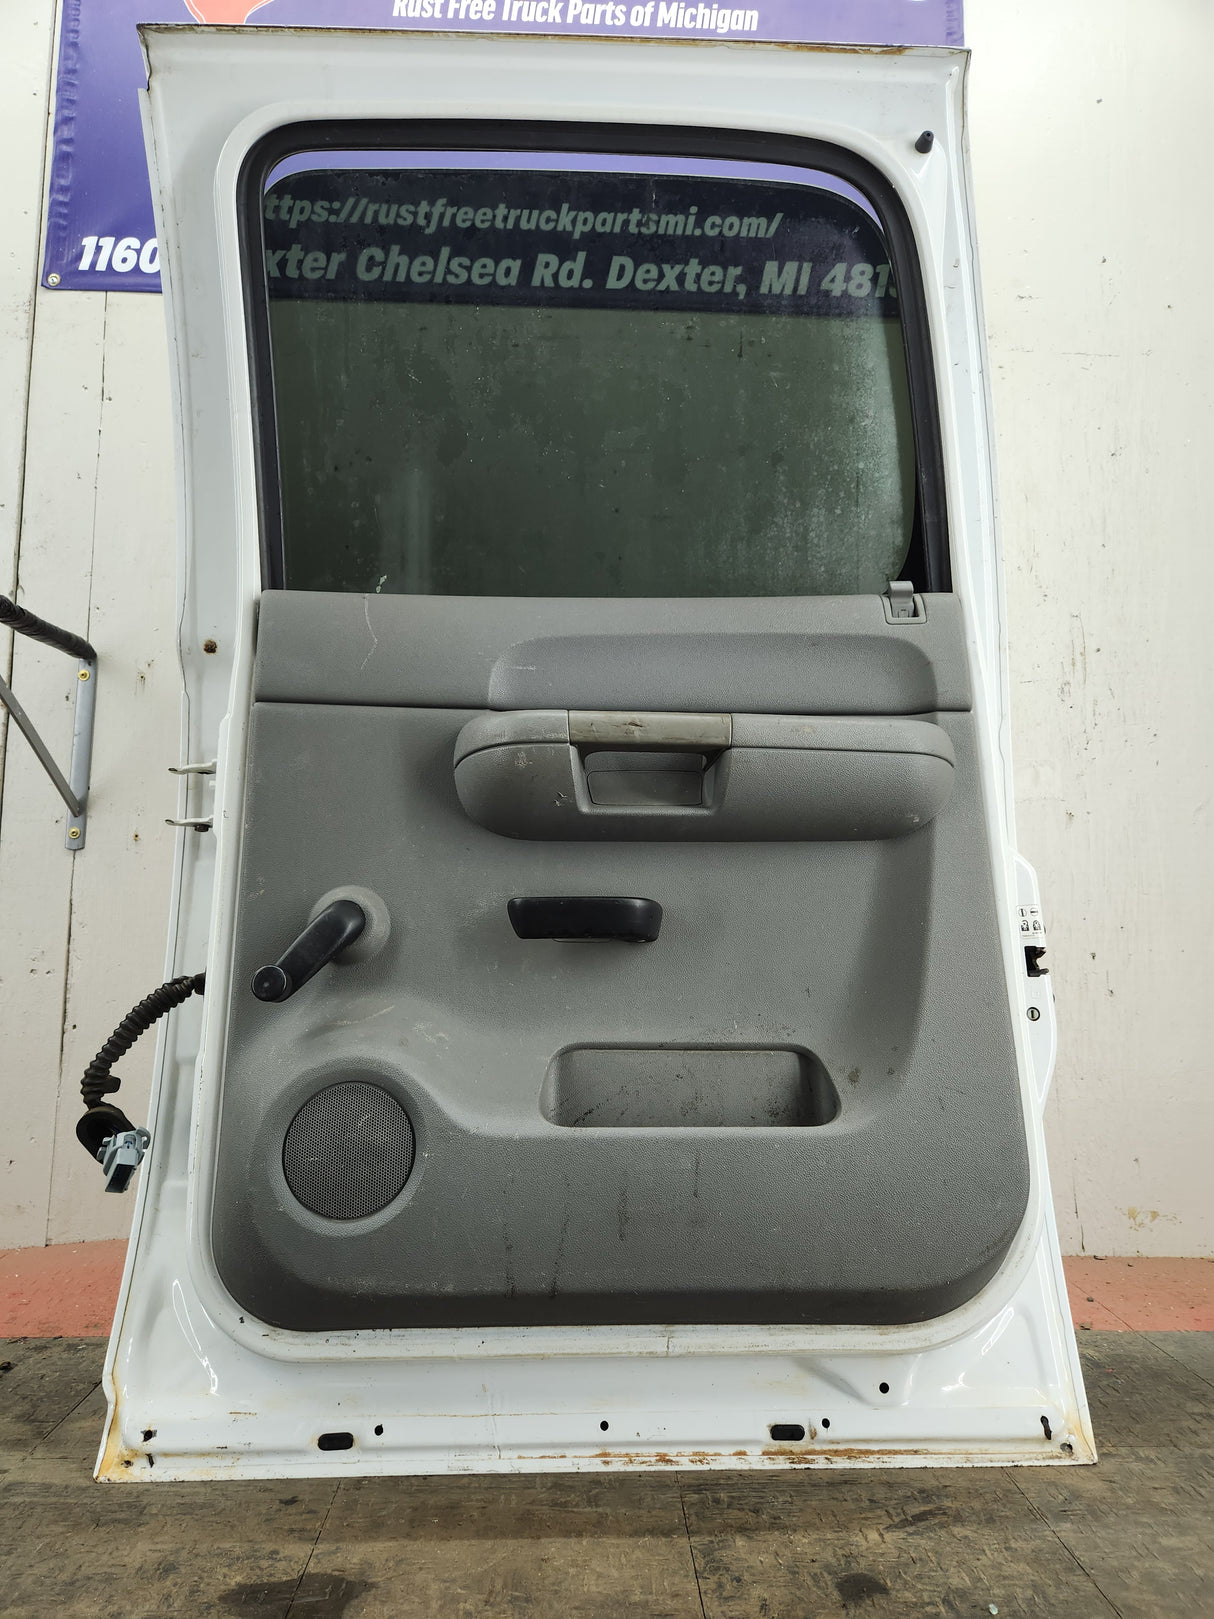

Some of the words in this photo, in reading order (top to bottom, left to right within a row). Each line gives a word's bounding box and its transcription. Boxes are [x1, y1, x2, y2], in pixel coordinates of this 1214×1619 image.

[392, 0, 443, 18] Rust
[447, 0, 497, 21] Free
[502, 0, 563, 24] Truck
[566, 0, 626, 27] Parts
[630, 2, 656, 27] of
[657, 2, 759, 33] Michigan
[78, 235, 161, 274] 1160
[356, 244, 522, 287] Chelsea
[531, 251, 594, 289] Rd.
[605, 255, 748, 300] Dexter,
[760, 260, 813, 295] MI
[821, 262, 898, 299] 481
